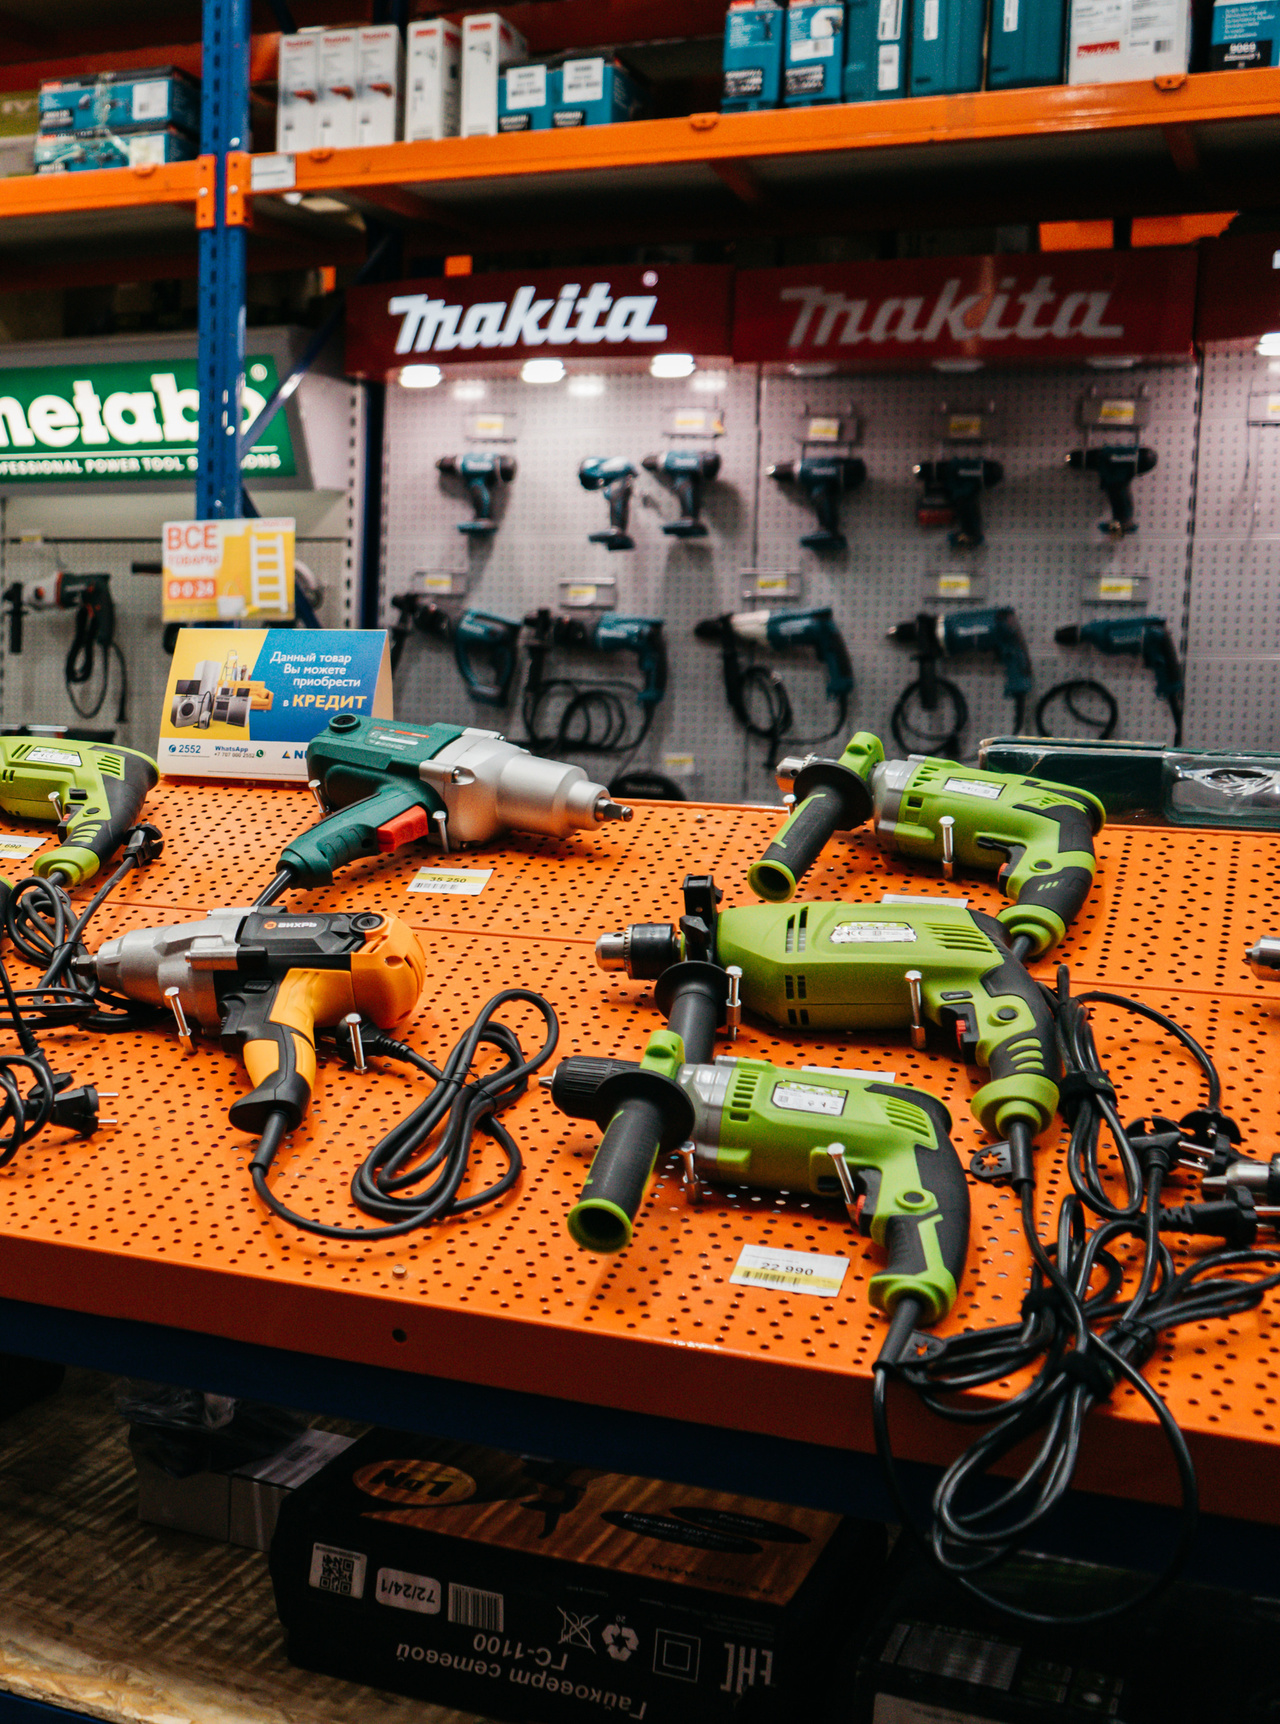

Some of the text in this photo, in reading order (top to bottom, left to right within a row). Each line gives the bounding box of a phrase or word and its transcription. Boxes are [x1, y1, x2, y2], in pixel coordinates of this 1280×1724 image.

[85, 457, 140, 474] POWER
[141, 456, 185, 471] TOOL
[167, 524, 218, 550] ВСЕ
[269, 651, 352, 665] Данный товар
[283, 663, 347, 675] Вы можете
[293, 676, 361, 689] приобрести
[292, 694, 367, 711] КРЕДИТ
[178, 744, 202, 754] 2552
[214, 745, 249, 753] WhatsApp
[760, 1262, 814, 1276] 22 990
[381, 1578, 436, 1604] 72/24/1
[473, 1632, 569, 1671] ГС-1100
[396, 1642, 648, 1720] Гайковерт сетевой
